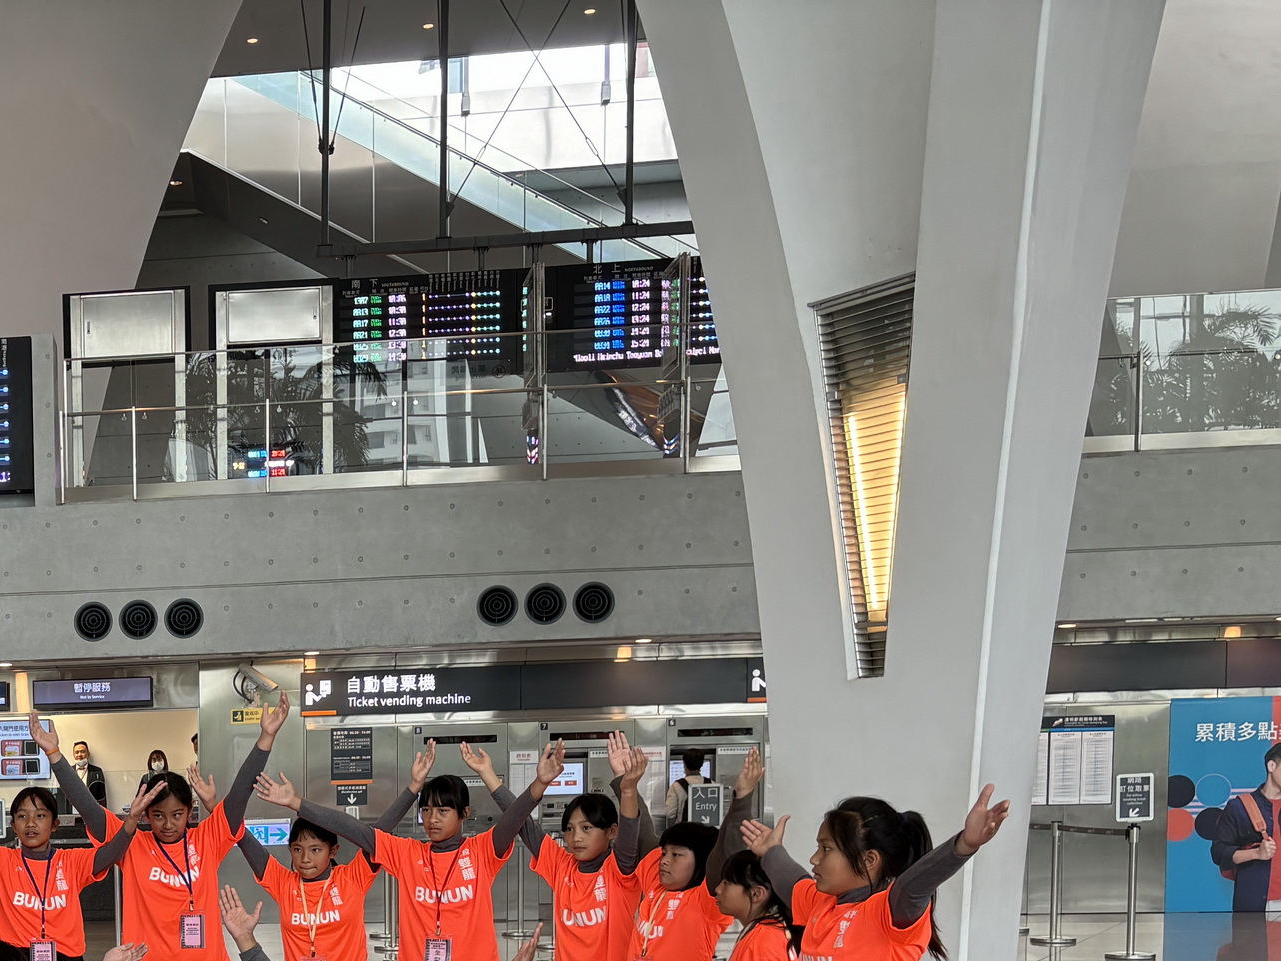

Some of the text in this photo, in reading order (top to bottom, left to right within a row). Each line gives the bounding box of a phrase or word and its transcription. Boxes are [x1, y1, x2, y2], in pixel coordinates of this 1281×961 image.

[74, 682, 111, 693] 暫停服務
[347, 674, 436, 694] 自動售票機
[348, 693, 471, 708] Ticket vending machine
[1195, 721, 1281, 742] 累積多點
[693, 787, 718, 799] 入口
[695, 802, 717, 812] Entry
[13, 891, 67, 911] BUNUN
[415, 884, 474, 904] BUNUN
[291, 909, 341, 926] BUNUN
[561, 906, 607, 927] UNUN
